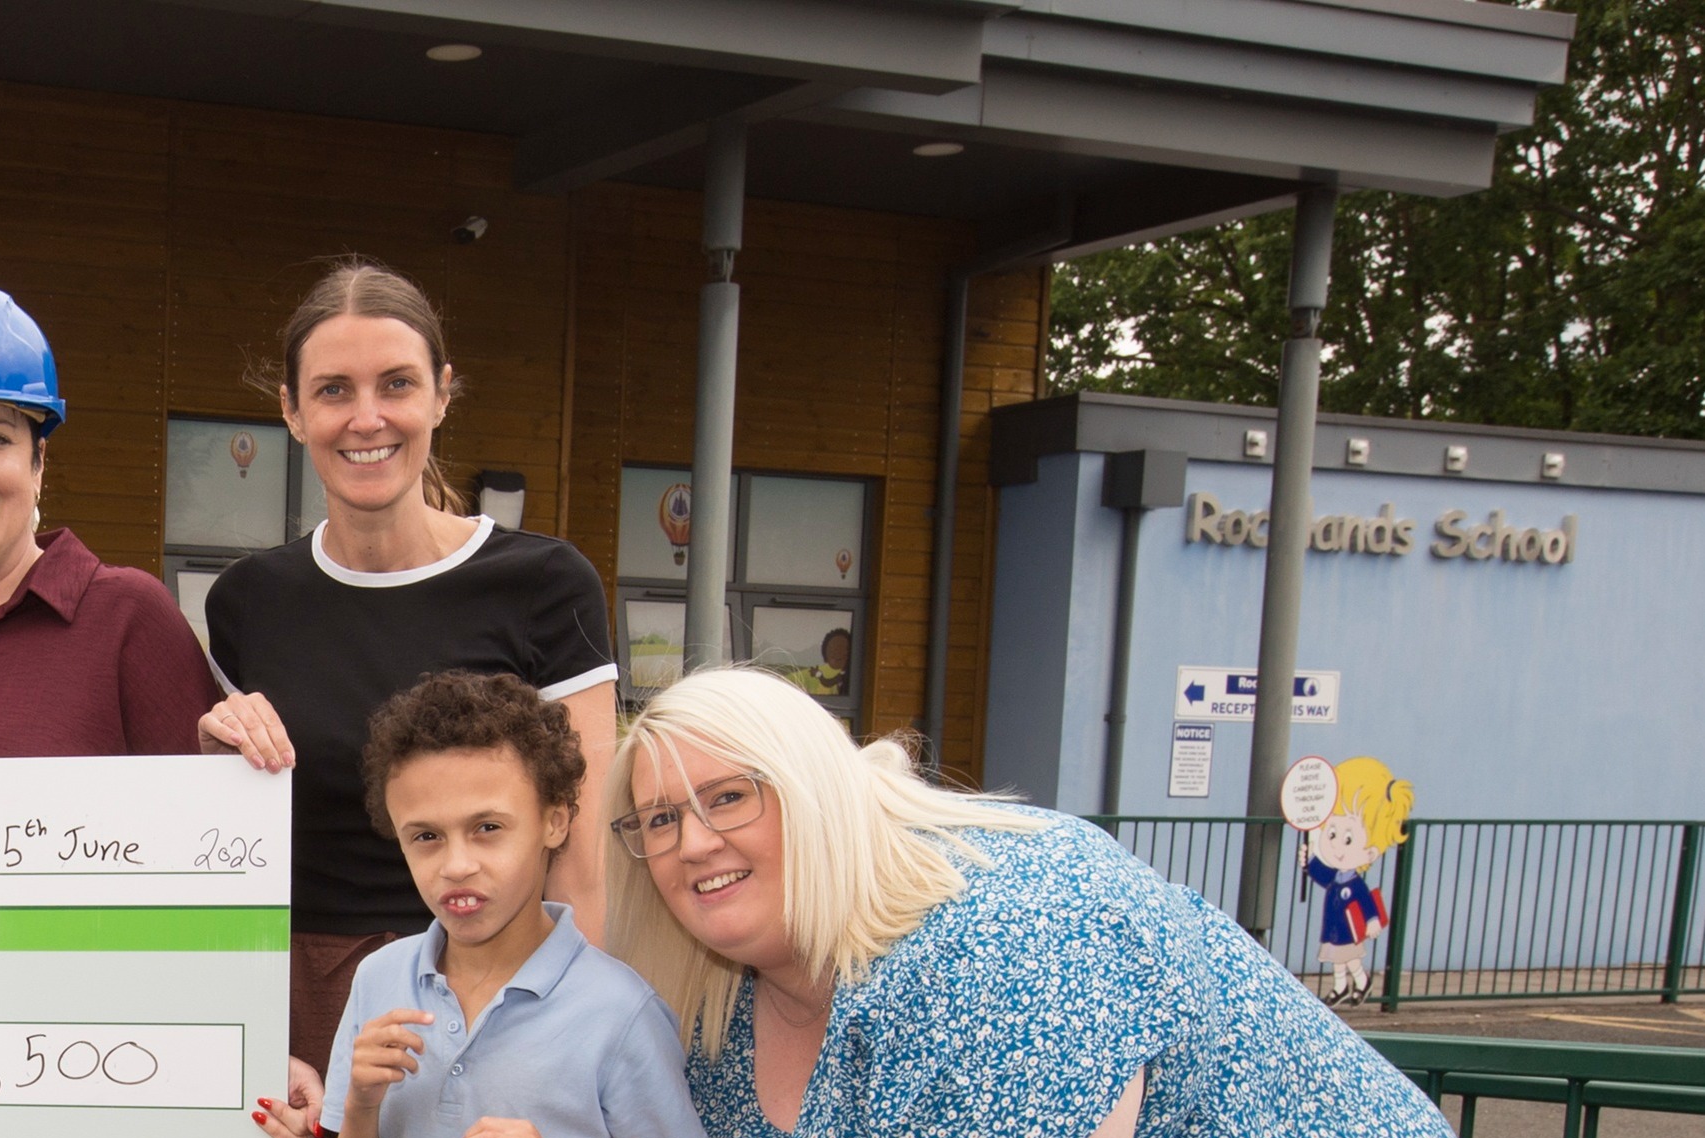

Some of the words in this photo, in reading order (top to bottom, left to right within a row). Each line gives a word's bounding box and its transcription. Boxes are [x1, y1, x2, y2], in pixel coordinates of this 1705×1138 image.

[1185, 490, 1416, 555] Roclands
[1430, 508, 1578, 565] School
[1211, 702, 1256, 714] RECEPT
[1306, 705, 1330, 717] WAY
[1176, 728, 1211, 739] NOTICE
[58, 825, 145, 865] June
[194, 828, 267, 870] 2026
